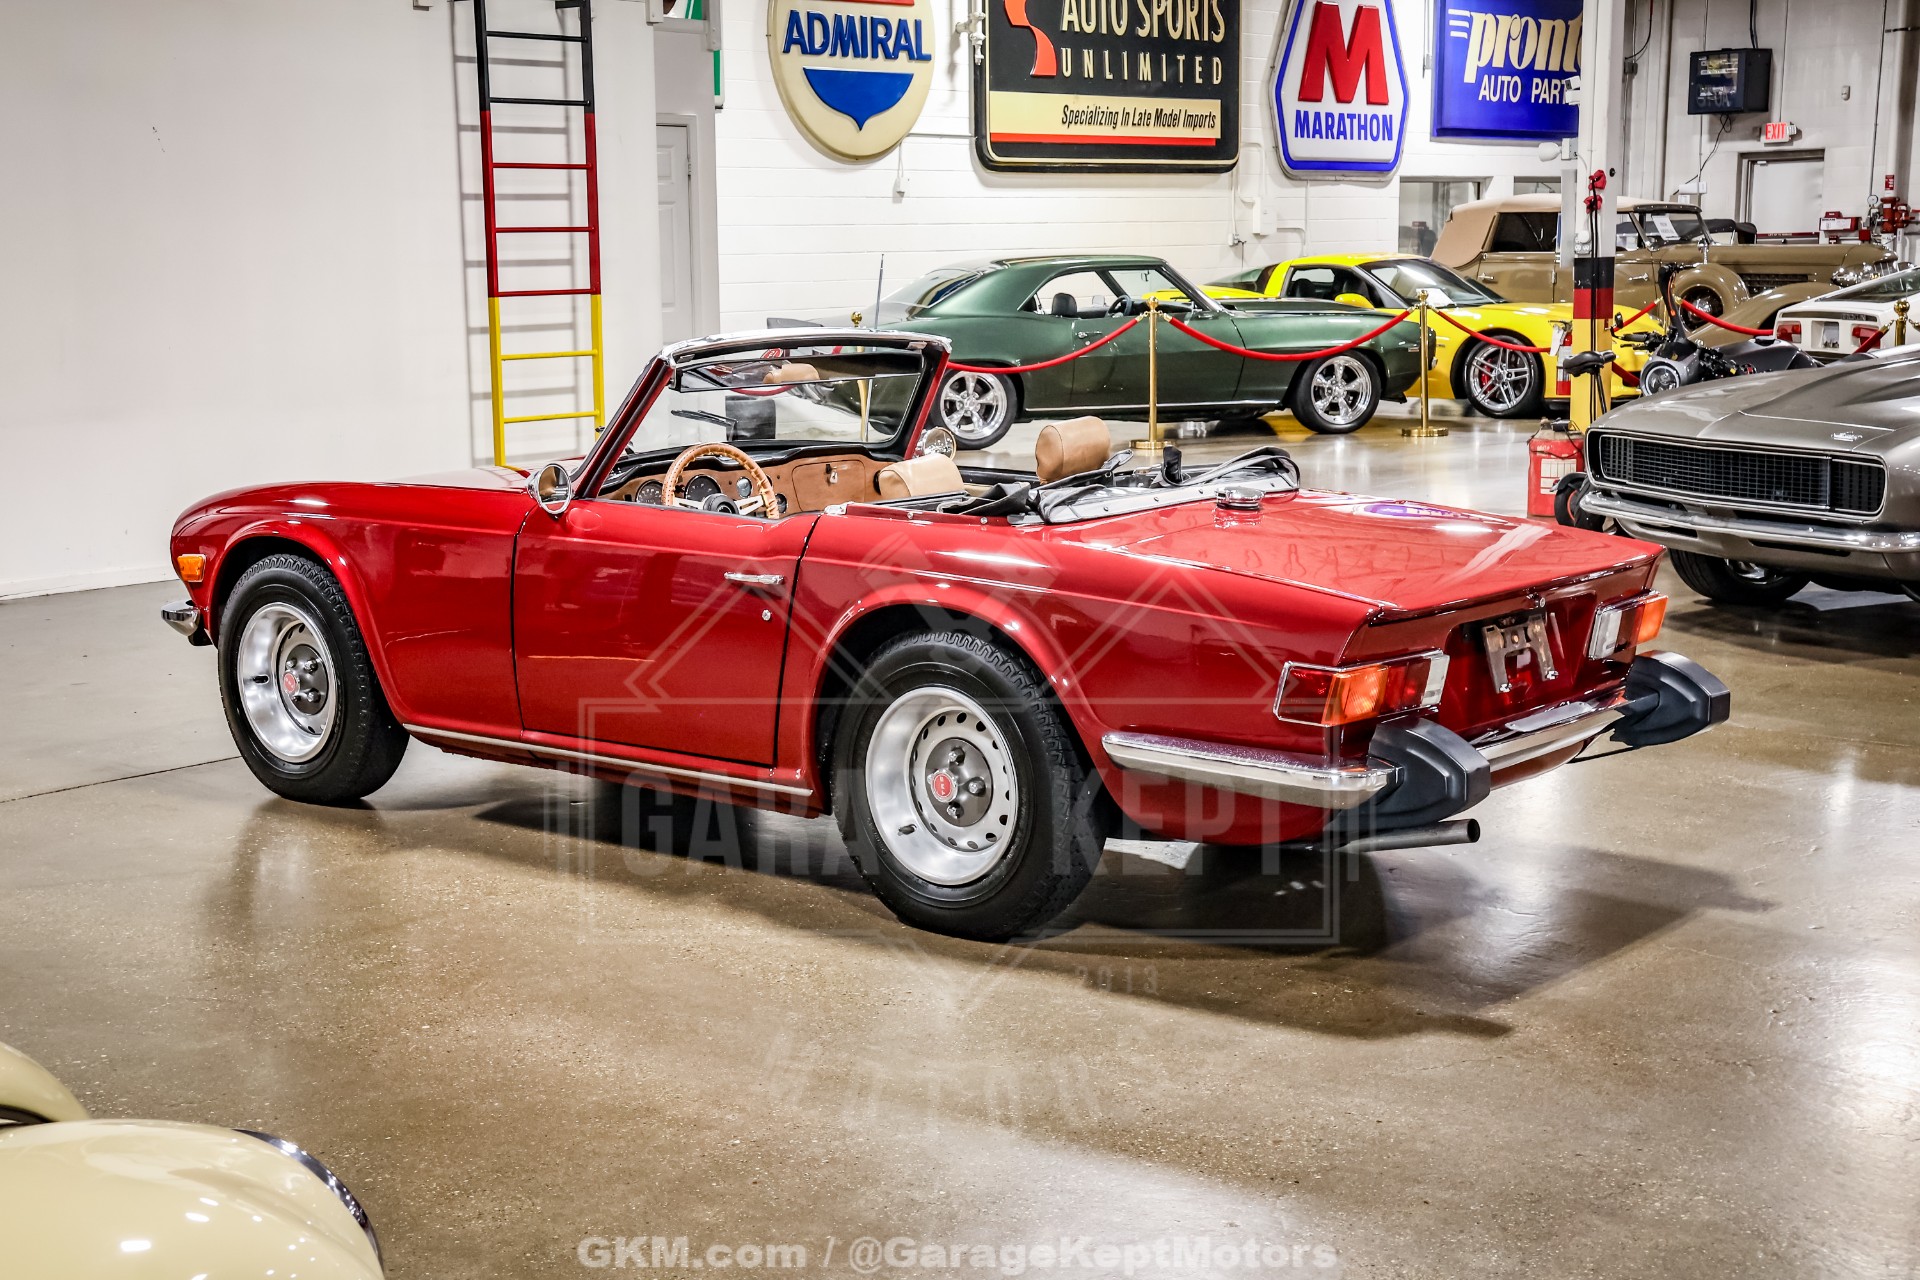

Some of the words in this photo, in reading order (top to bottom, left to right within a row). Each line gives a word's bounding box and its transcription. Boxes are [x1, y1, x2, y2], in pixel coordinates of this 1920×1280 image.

[782, 10, 932, 61] ADMIRAL
[1060, 0, 1128, 36] AUTO
[1135, 0, 1225, 43] SPORTS
[1061, 47, 1222, 85] UNLIMITED
[1298, 1, 1389, 106] M
[1464, 11, 1583, 84] pront
[1479, 74, 1522, 103] AUTO
[1531, 78, 1568, 105] PART
[1062, 104, 1119, 130] Specializing
[1121, 107, 1130, 126] In
[1132, 107, 1151, 127] Late
[1153, 108, 1182, 128] Model
[1183, 109, 1217, 131] Imports
[1294, 110, 1393, 141] MARATHON
[1765, 122, 1787, 140] EXIT
